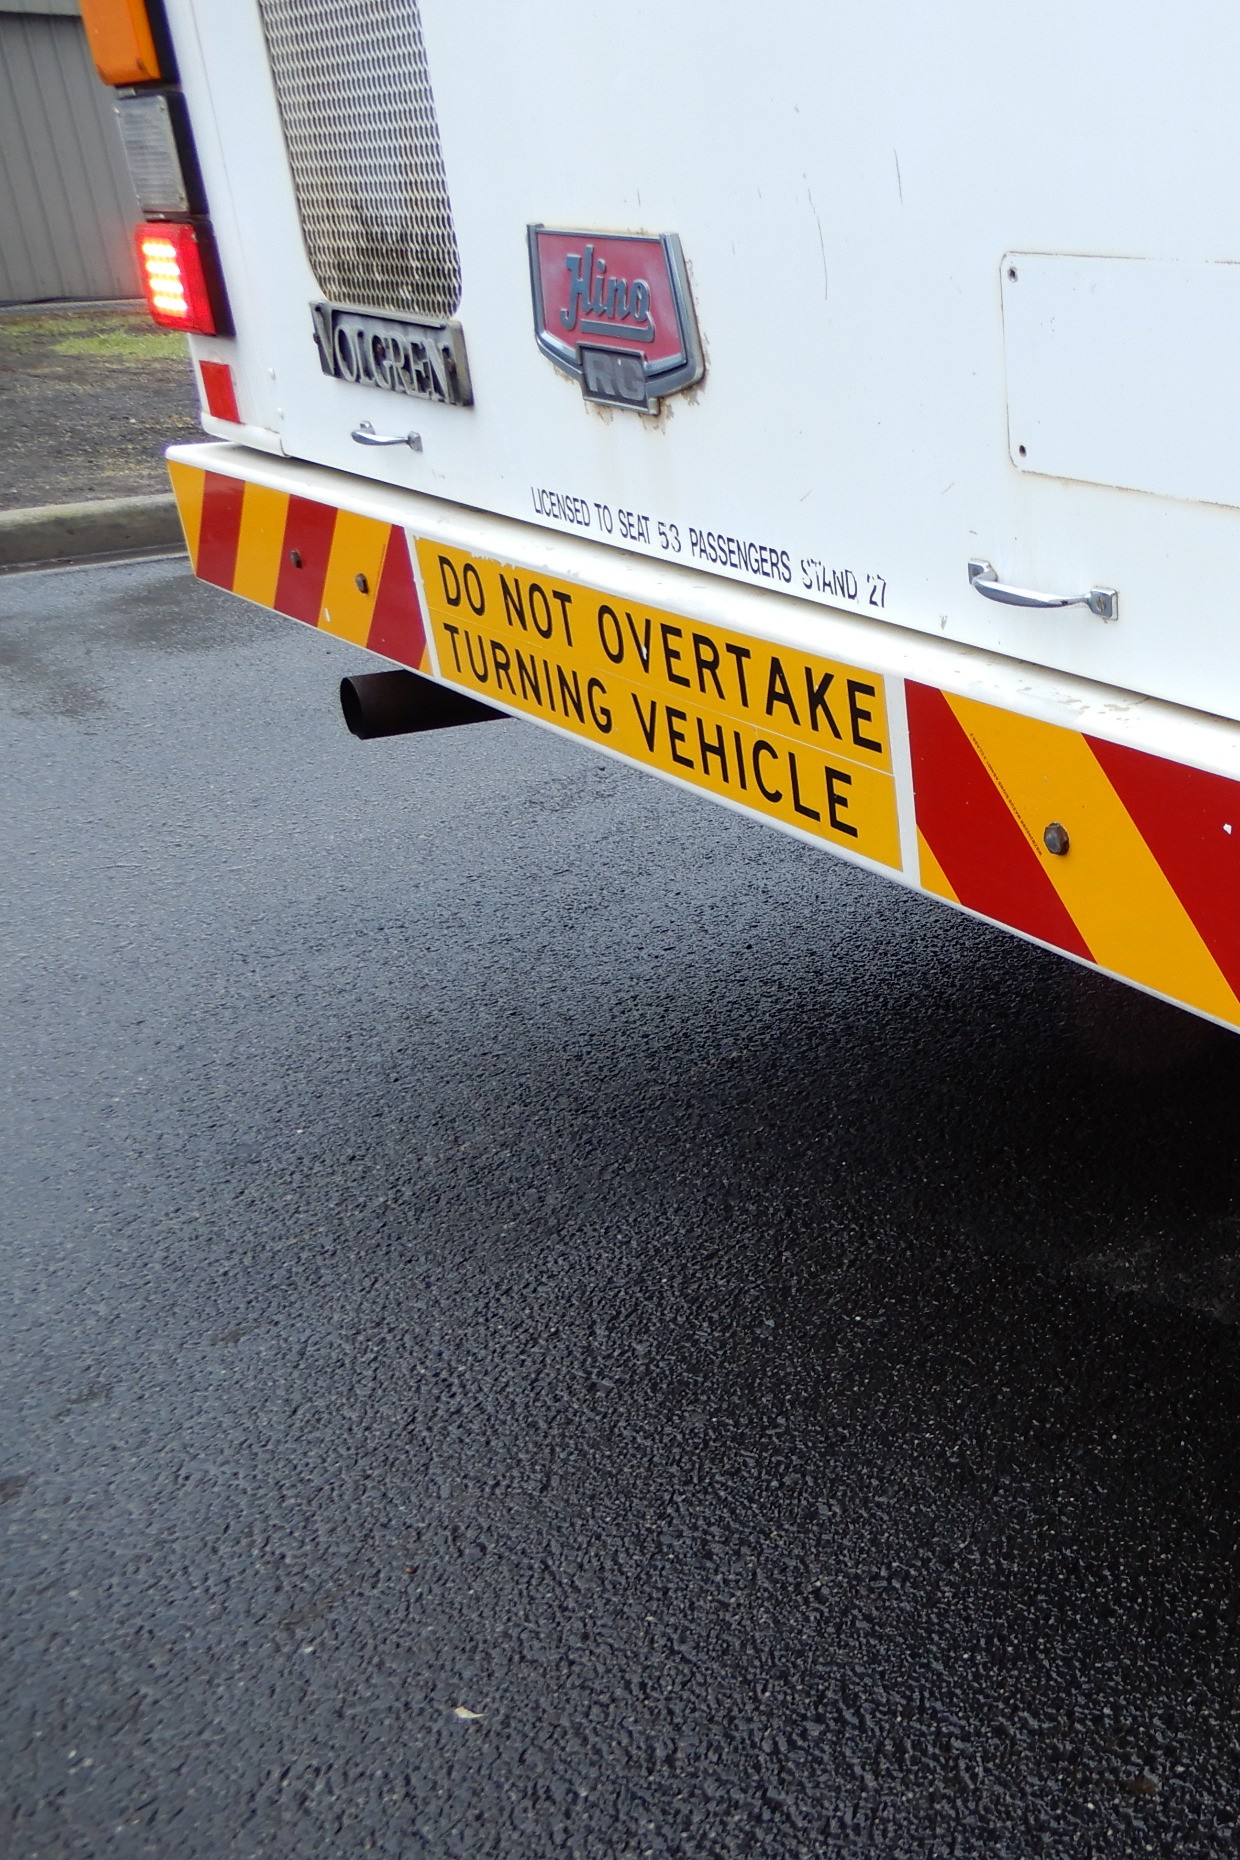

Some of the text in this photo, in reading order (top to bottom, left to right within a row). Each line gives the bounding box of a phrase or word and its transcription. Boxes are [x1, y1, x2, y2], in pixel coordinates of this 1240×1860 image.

[561, 244, 654, 342] Hino
[310, 303, 460, 407] VOLGREN
[531, 486, 591, 527] LICENSED
[594, 502, 613, 534] TO
[618, 508, 651, 545] SEAT
[657, 521, 682, 553] 53
[689, 527, 792, 584] PASSENGERS
[800, 558, 858, 601] STAND
[438, 555, 883, 754] DO NOT OVERTAKE
[442, 622, 858, 839] TURNING VEHICLE
